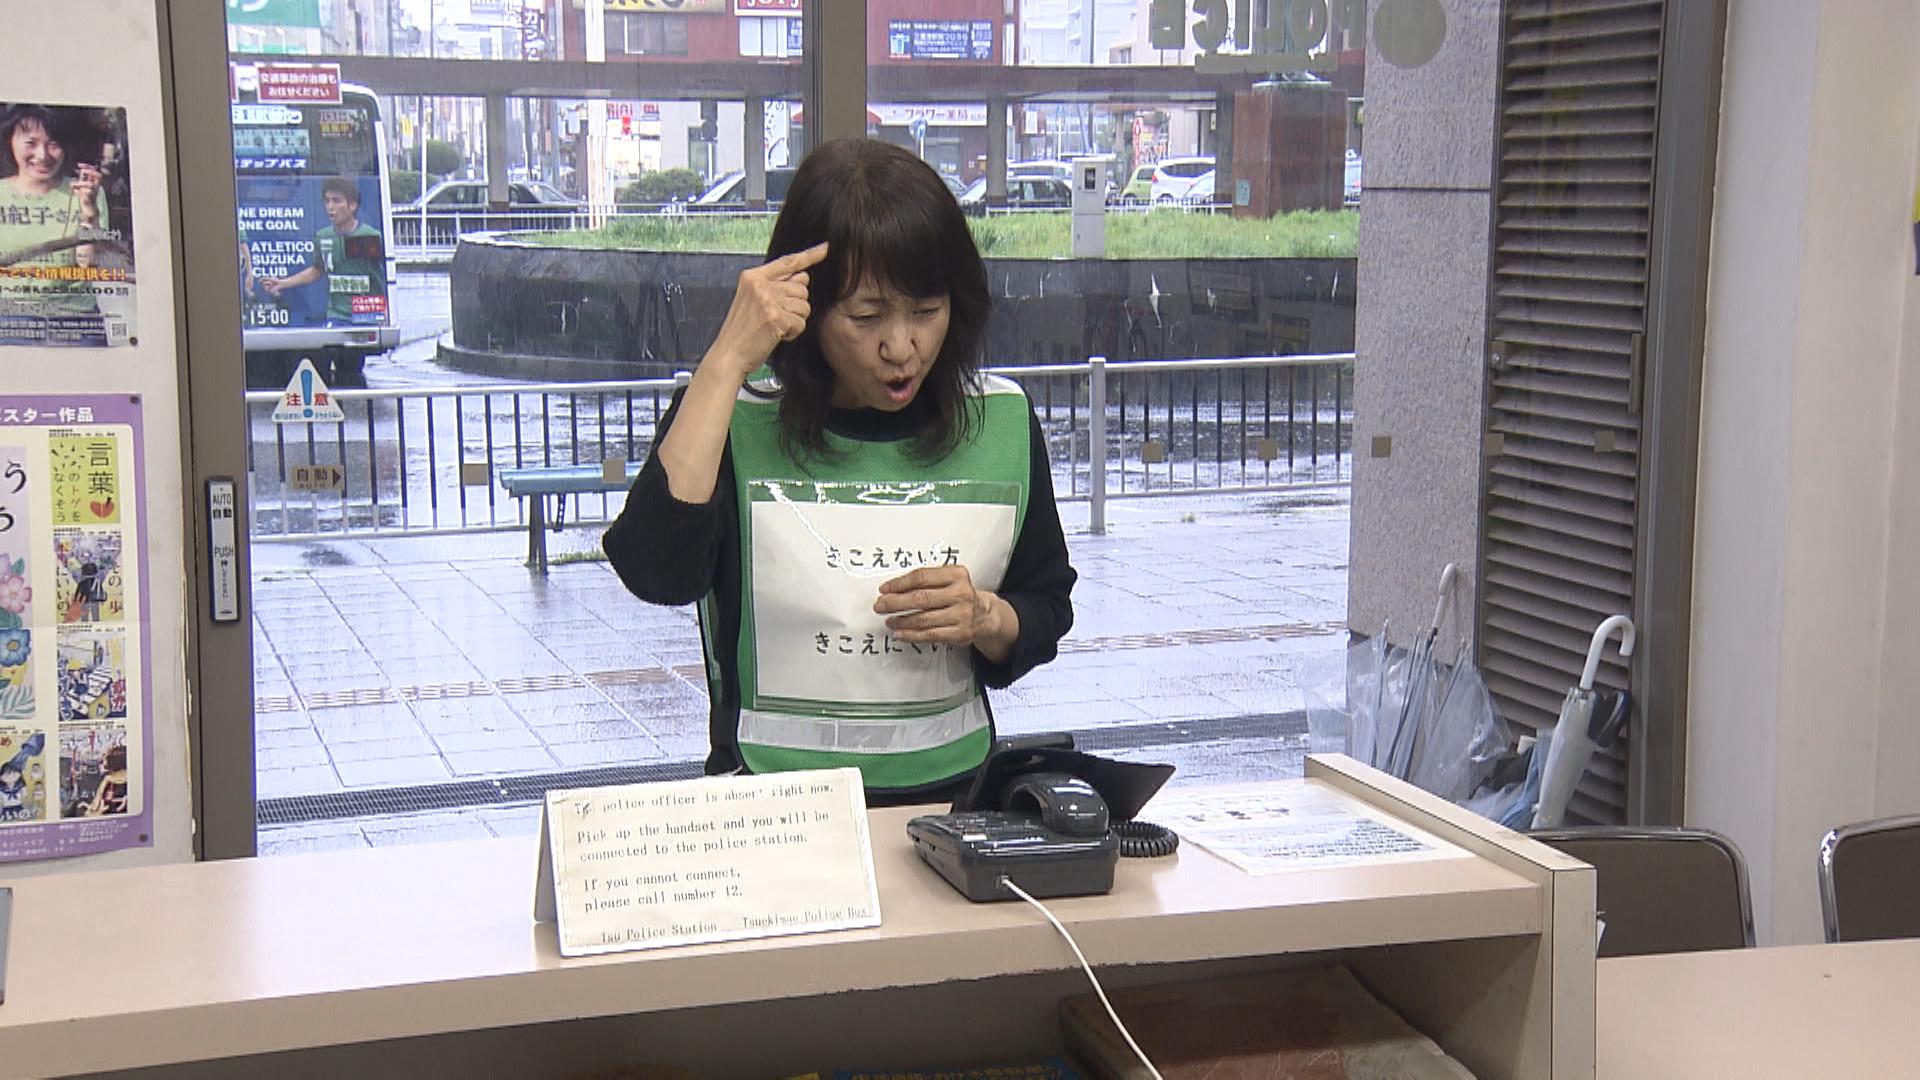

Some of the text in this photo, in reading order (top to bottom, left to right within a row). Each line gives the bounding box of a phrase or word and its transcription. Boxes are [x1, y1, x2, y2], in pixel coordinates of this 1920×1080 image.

[259, 207, 304, 218] DREAM
[238, 220, 299, 231] ONE GOAL
[251, 241, 314, 252] ATLETICO
[252, 254, 305, 265] SUZUKA
[253, 267, 287, 277] CLUB
[0, 407, 94, 422] スター作品
[86, 442, 114, 495] 言葉
[213, 494, 232, 505] AUTO
[215, 546, 234, 558] PUSH
[603, 798, 645, 813] police
[651, 794, 697, 807] officer
[706, 792, 718, 802] is
[772, 783, 804, 797] right
[810, 782, 834, 795] now.
[577, 810, 829, 845] Pick up the handset and you will be
[580, 831, 808, 862] connected to the police station.
[584, 878, 598, 892] If
[606, 878, 629, 891] you
[636, 871, 679, 885] cannot
[584, 897, 631, 914] please
[638, 890, 666, 905] call
[673, 888, 717, 903] number
[804, 908, 842, 922] Police
[626, 925, 666, 942] Police
[671, 920, 718, 935] Station
